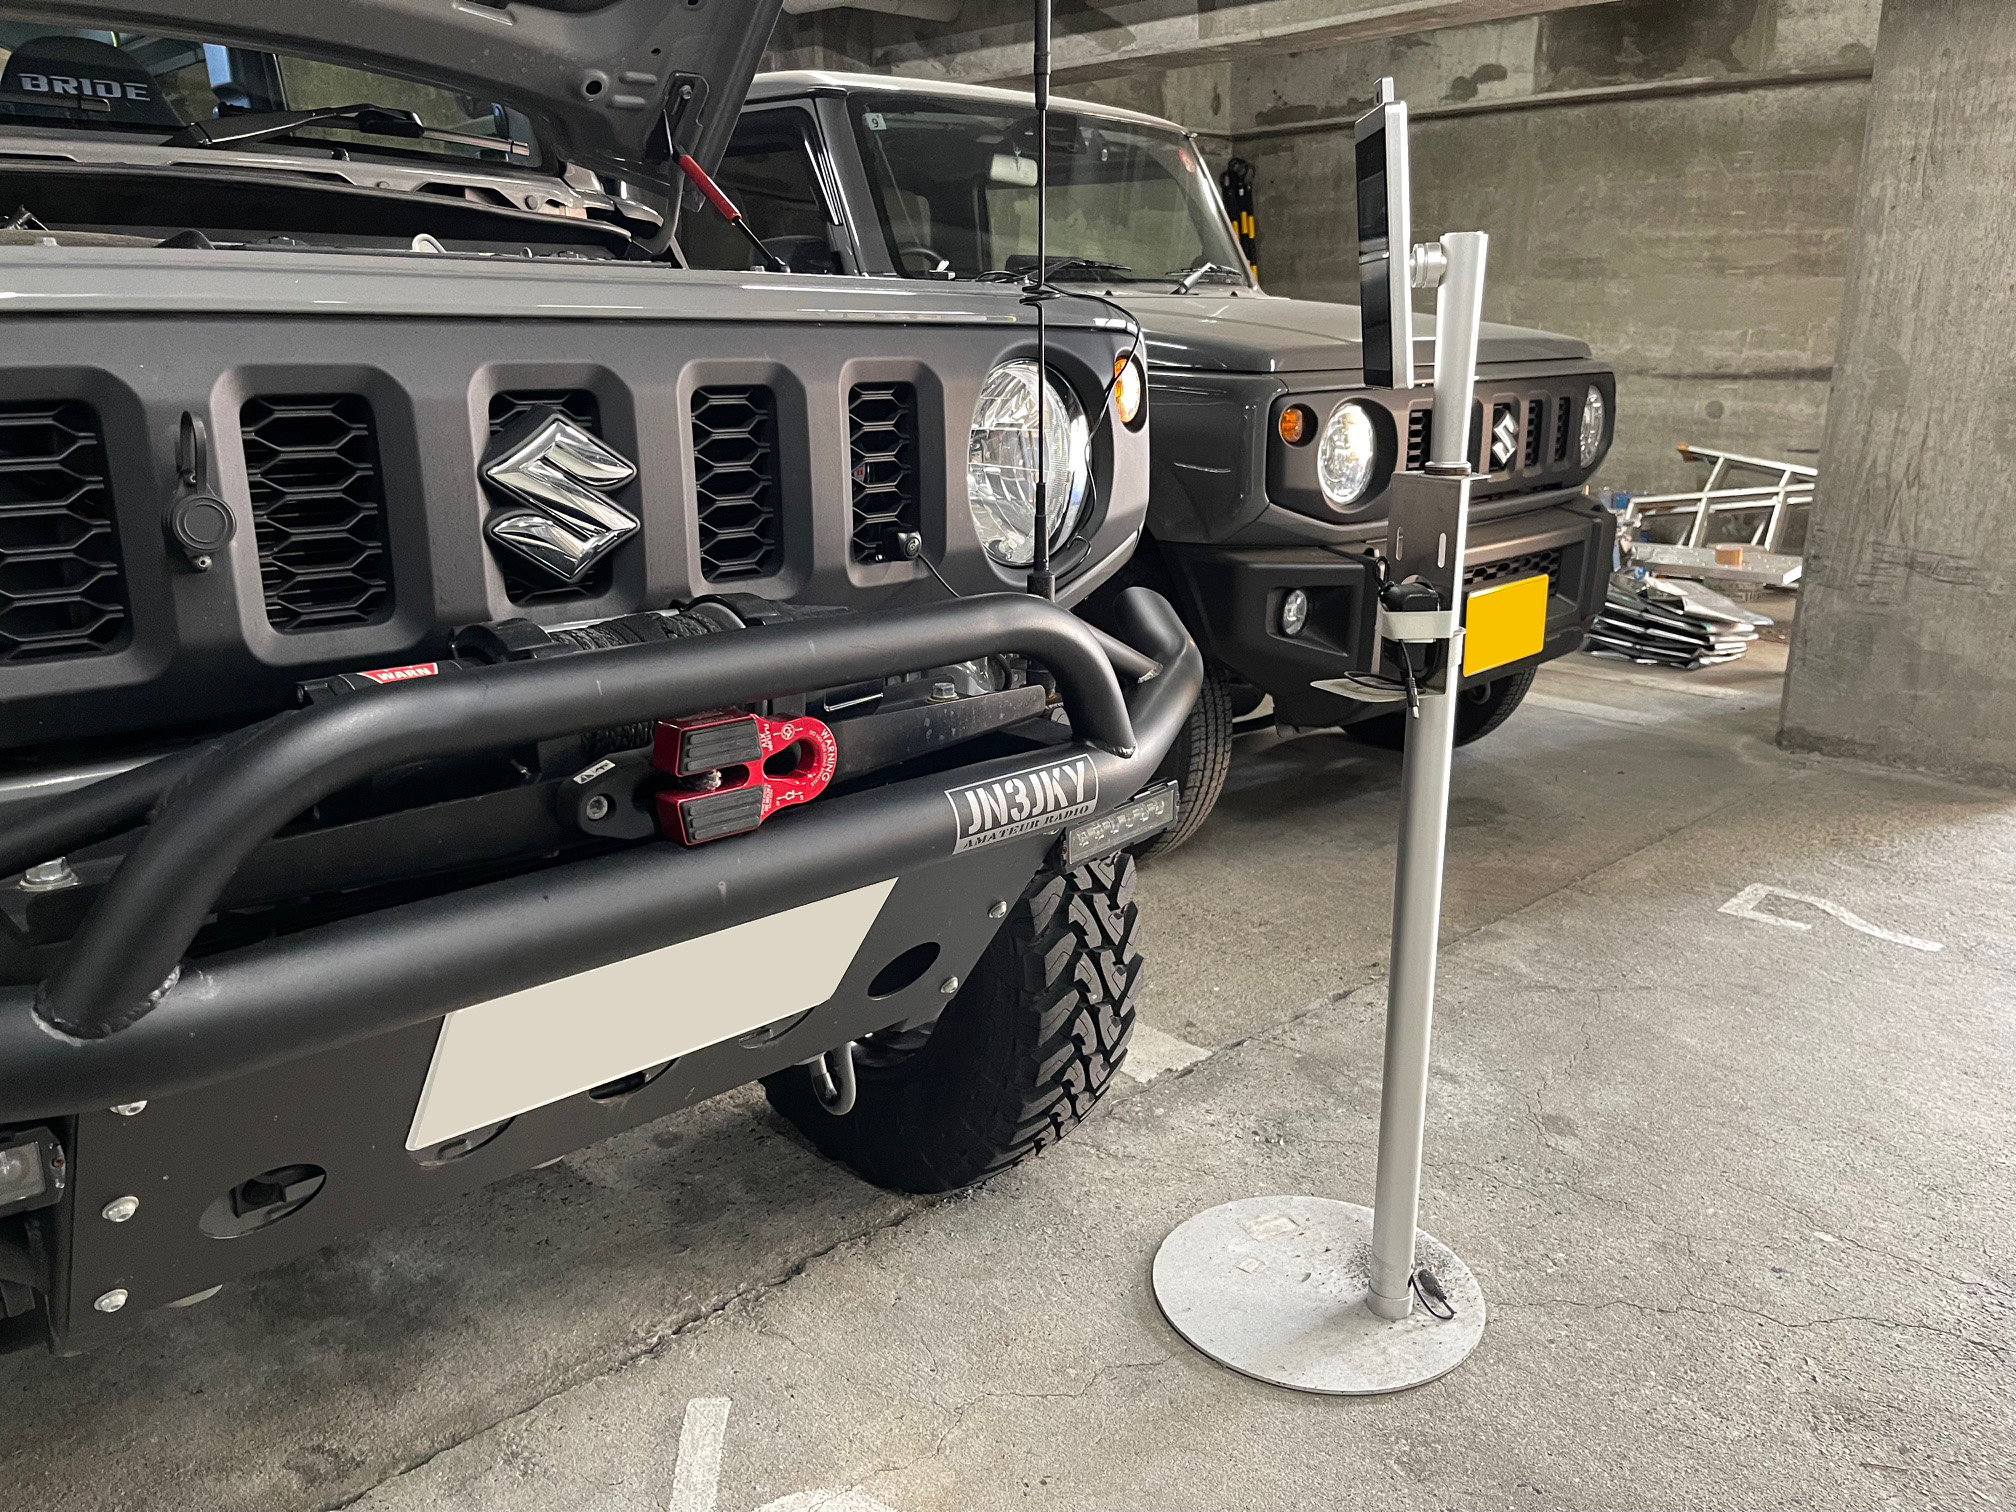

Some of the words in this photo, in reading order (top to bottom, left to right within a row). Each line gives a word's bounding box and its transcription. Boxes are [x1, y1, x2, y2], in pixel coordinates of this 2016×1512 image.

[17, 73, 151, 101] BRIDE
[377, 667, 432, 681] WARN
[820, 728, 835, 782] WARNING
[964, 760, 1085, 835] JN3JKY
[962, 819, 1040, 849] AMATEUR
[1043, 804, 1090, 825] RADIO
